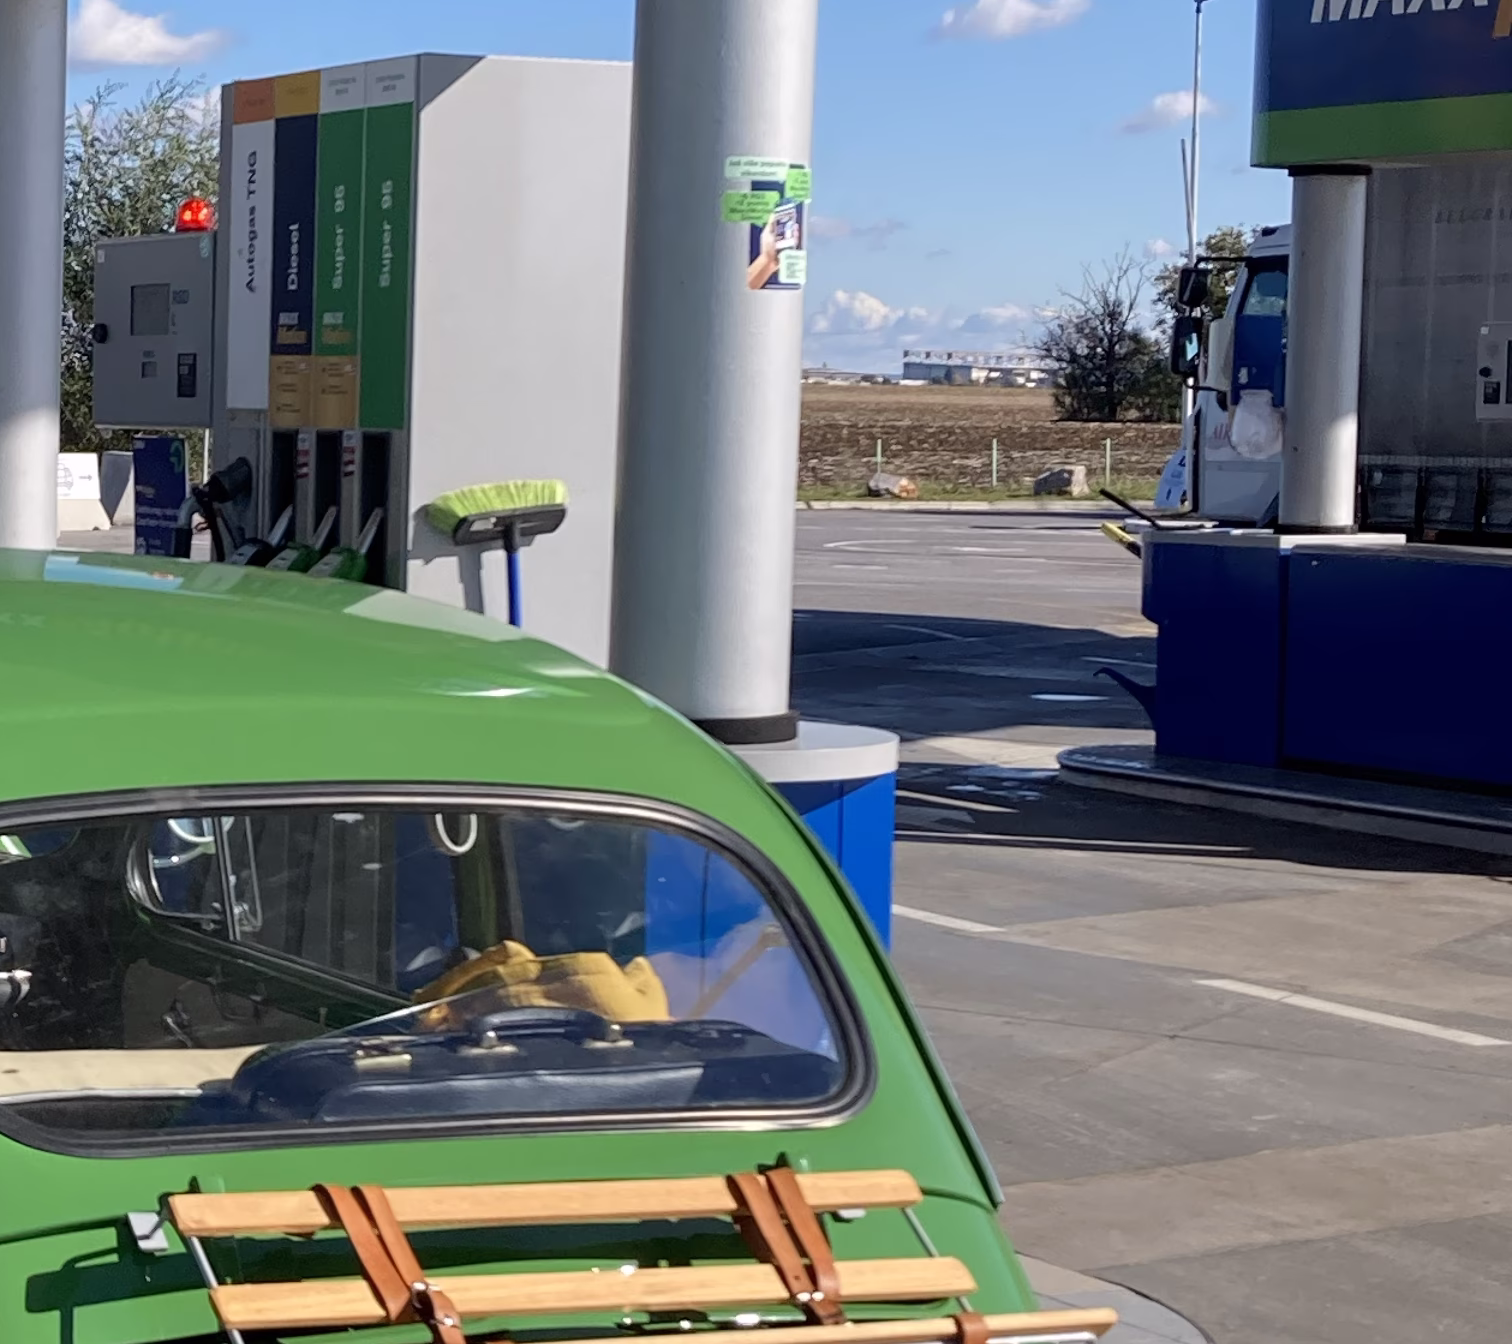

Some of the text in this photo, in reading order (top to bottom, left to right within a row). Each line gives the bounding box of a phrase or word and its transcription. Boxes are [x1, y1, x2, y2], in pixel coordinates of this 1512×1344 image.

[245, 150, 258, 293] Autogas TNG
[287, 221, 300, 291] Diesel
[379, 219, 393, 288] Super
[332, 223, 345, 290] Super
